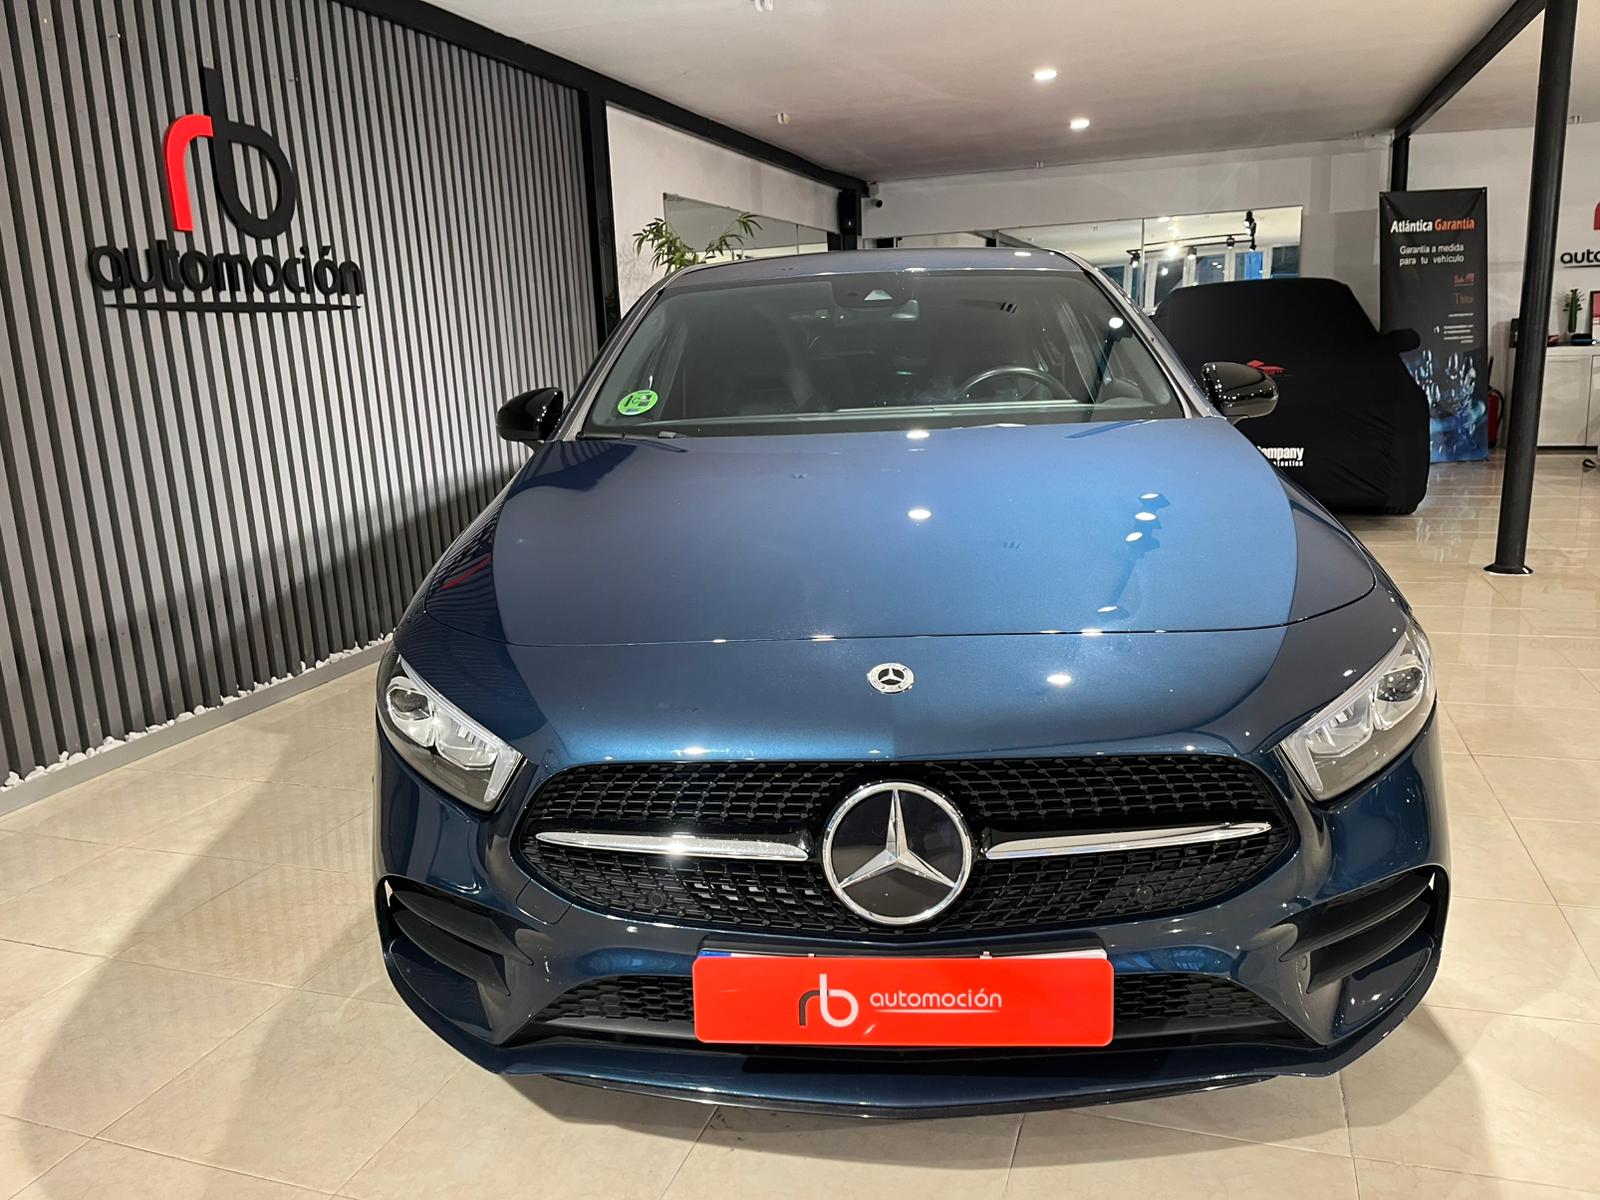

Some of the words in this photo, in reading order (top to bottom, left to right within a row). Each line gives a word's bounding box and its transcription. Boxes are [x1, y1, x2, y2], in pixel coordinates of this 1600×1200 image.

[163, 67, 297, 239] rb
[1390, 219, 1433, 234] Atlántica
[1437, 243, 1464, 252] medida
[88, 240, 364, 296] automoción
[1399, 257, 1417, 267] para
[1420, 256, 1429, 264] tu
[1257, 446, 1304, 461] ompany
[799, 973, 859, 1027] rb
[869, 988, 1002, 1008] automoción
